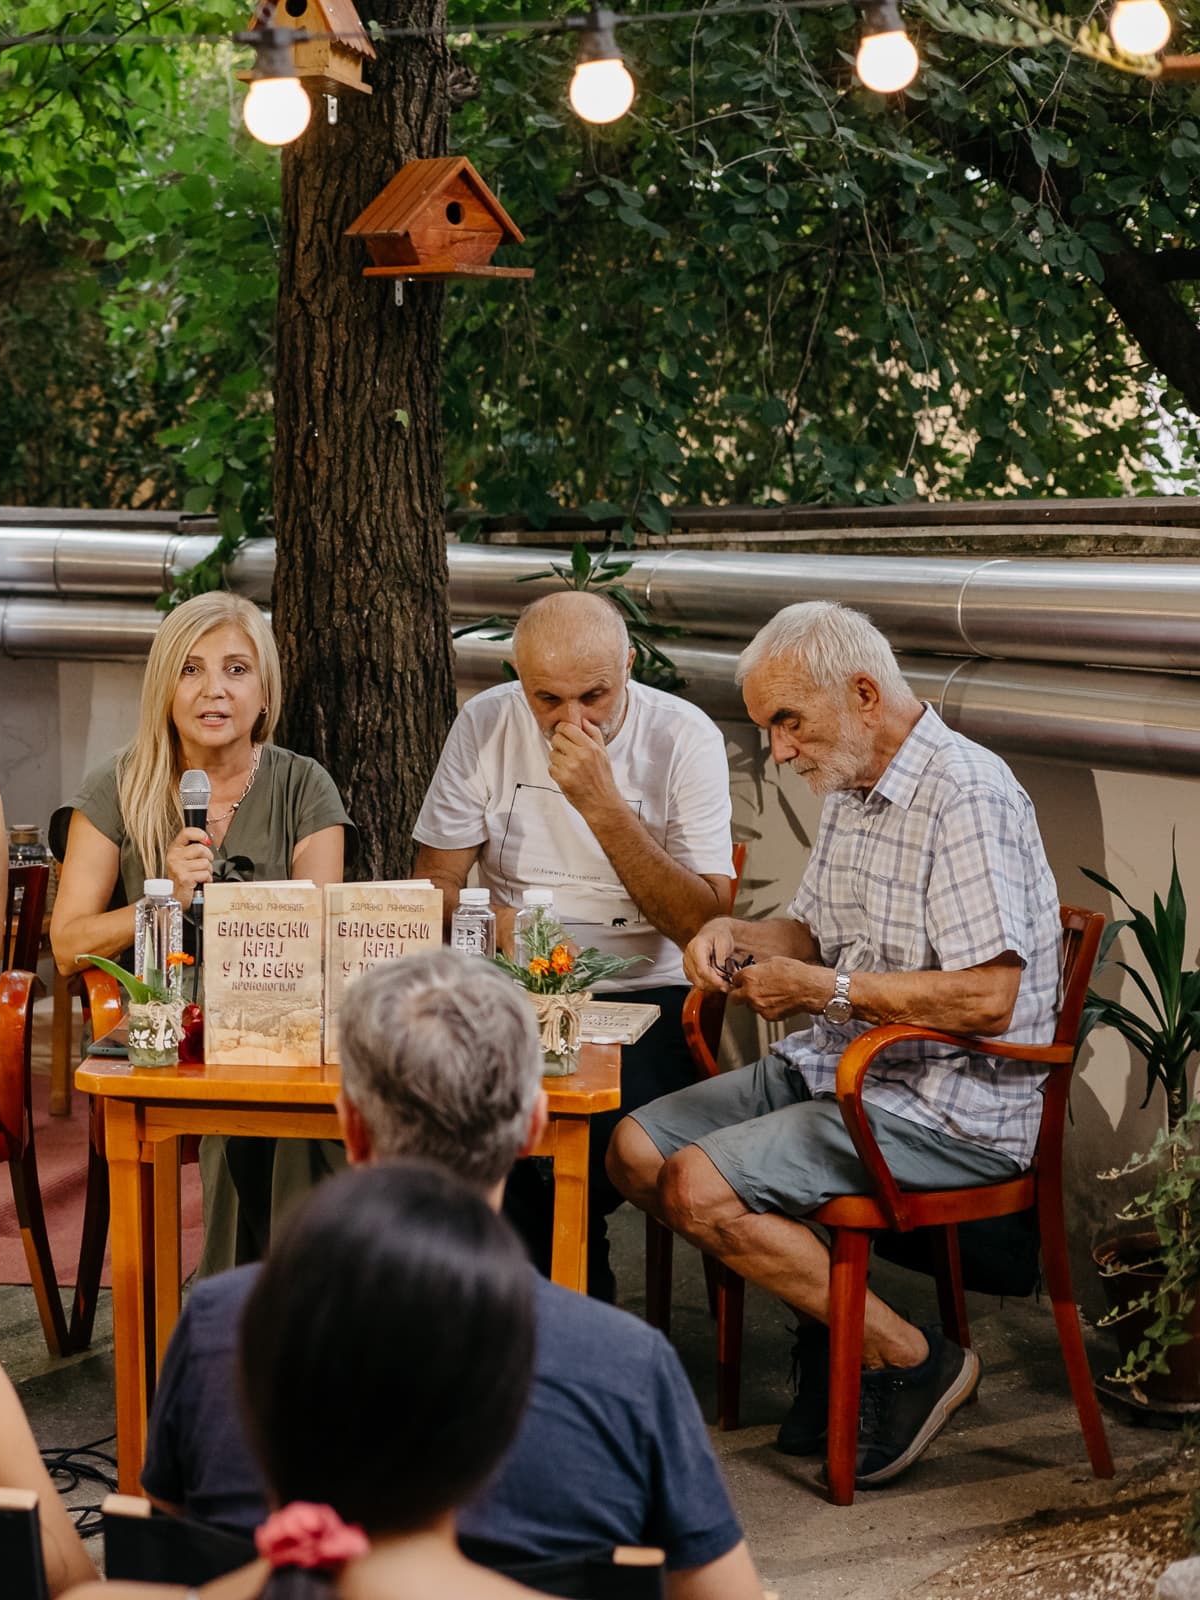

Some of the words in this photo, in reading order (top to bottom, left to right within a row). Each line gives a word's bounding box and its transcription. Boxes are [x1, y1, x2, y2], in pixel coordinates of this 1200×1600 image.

[217, 921, 310, 938] ВАЉЕВСКИ
[337, 921, 430, 939] ВАЉЕВСКИ
[243, 940, 284, 958] КРАЈ
[262, 961, 304, 979] ВЕКУ
